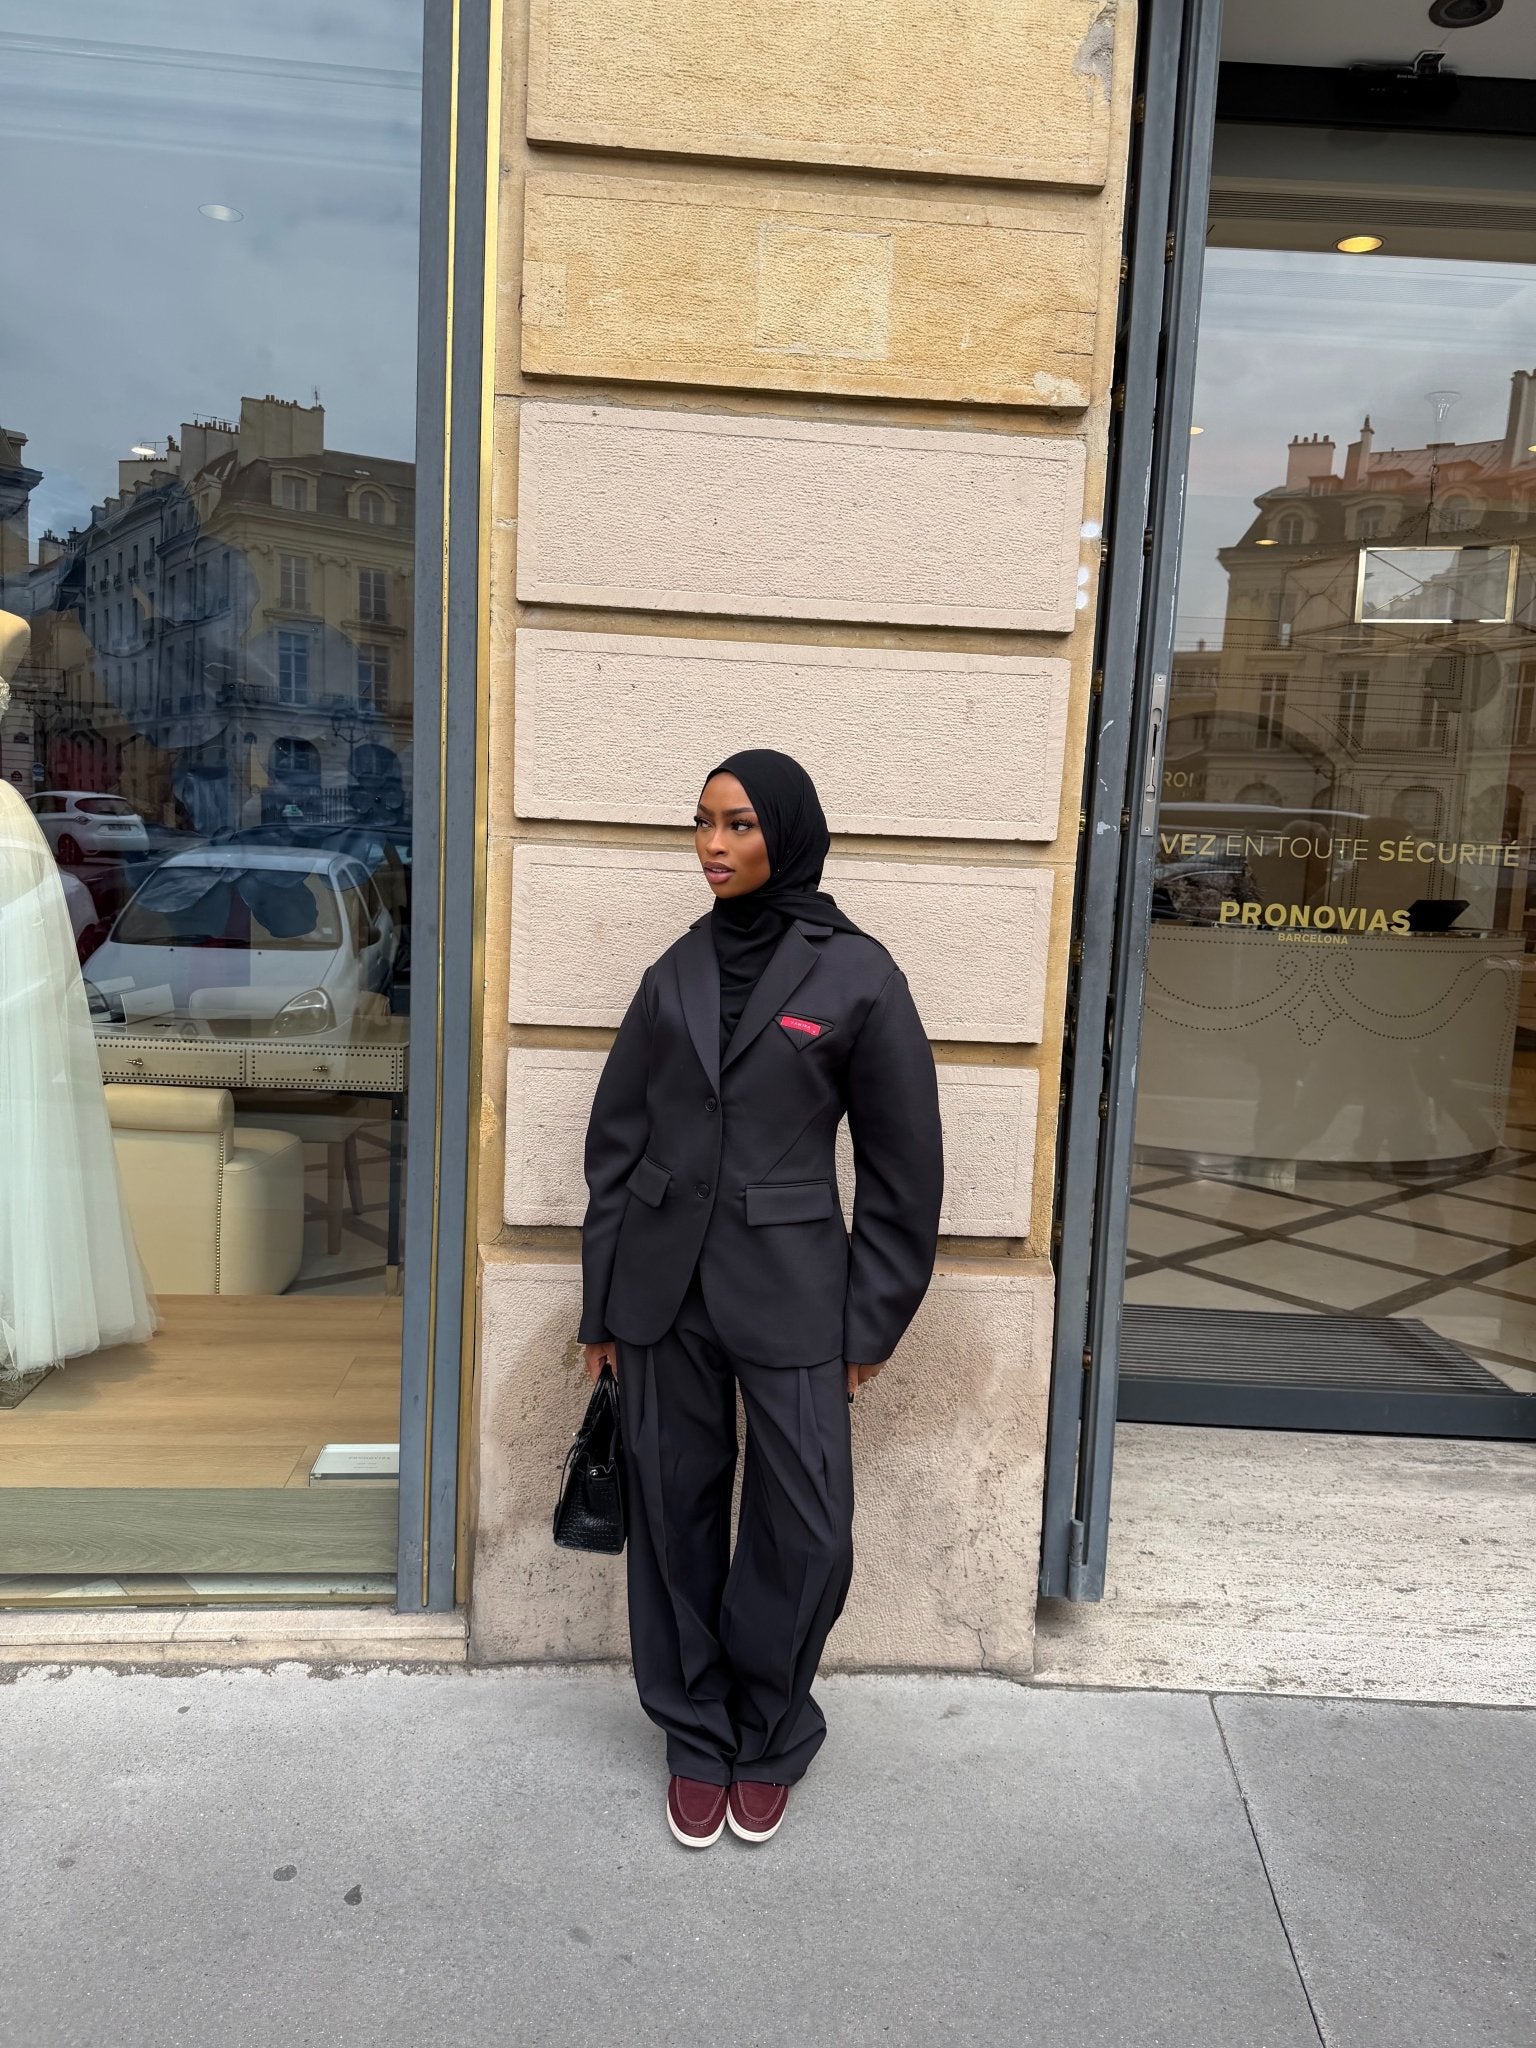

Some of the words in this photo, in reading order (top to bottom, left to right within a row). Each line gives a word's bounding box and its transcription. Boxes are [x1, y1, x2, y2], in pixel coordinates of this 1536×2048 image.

[1160, 833, 1217, 856] VEZ
[1226, 835, 1264, 857] EN
[1273, 836, 1369, 860] TOUTE
[1378, 835, 1521, 867] SÉCURITÉ
[1219, 901, 1411, 936] PRONOVIAS
[1278, 932, 1349, 945] BARCELONA
